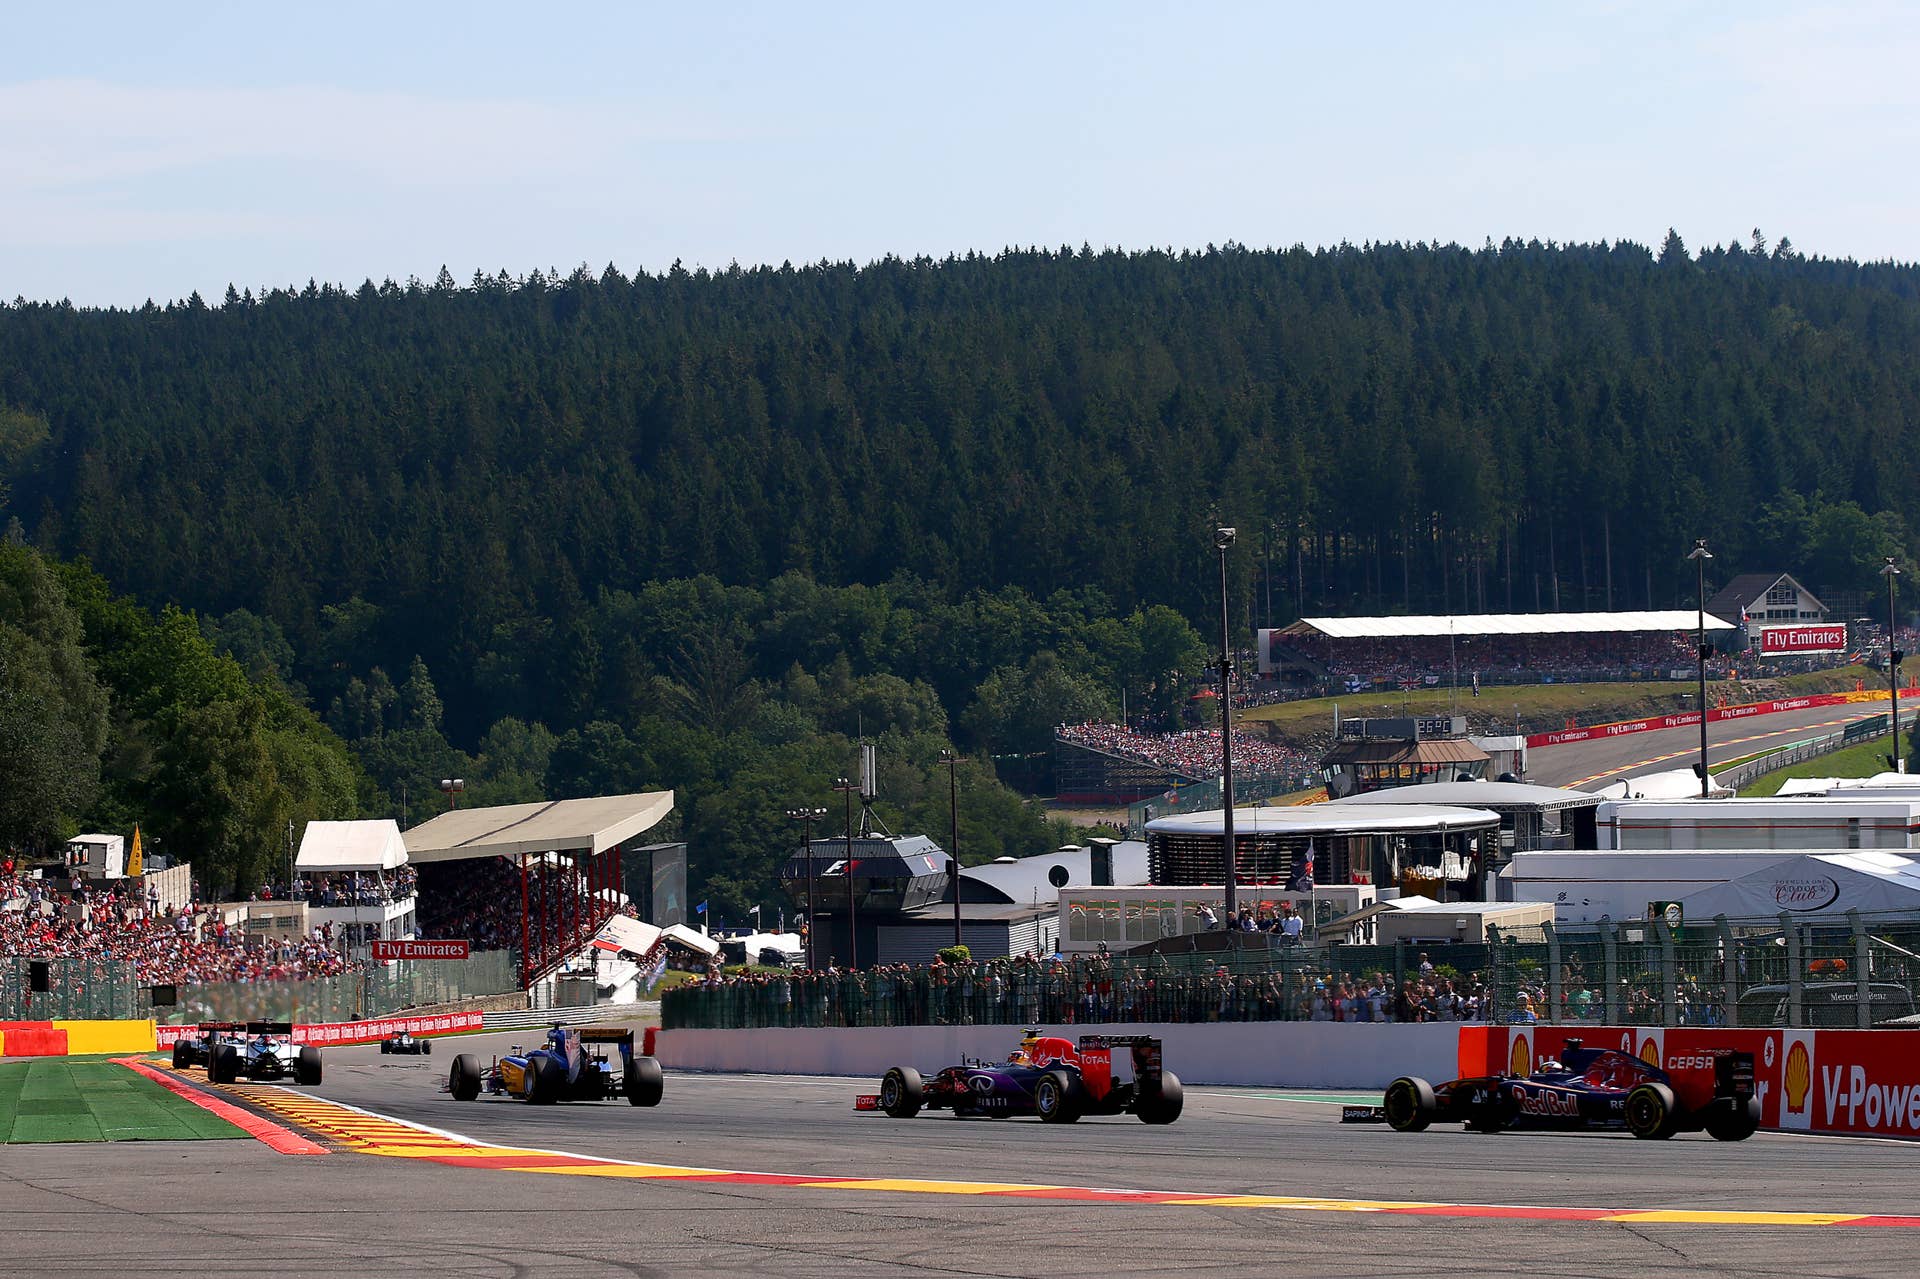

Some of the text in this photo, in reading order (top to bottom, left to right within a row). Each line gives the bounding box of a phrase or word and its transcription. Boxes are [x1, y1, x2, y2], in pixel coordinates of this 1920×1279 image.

[1767, 630, 1840, 648] Fly Emirates
[1773, 701, 1784, 710] Fly
[1665, 715, 1702, 726] Fly Emirate
[1721, 710, 1732, 718] Fly
[1607, 722, 1647, 735] Fly Emirates
[378, 942, 465, 958] Fly Emirates
[1080, 1054, 1111, 1065] TOTAL
[1668, 1056, 1714, 1070] CEPSA
[1512, 1085, 1548, 1116] Red
[1546, 1090, 1580, 1117] Bull
[1822, 1065, 1920, 1130] V-Powe
